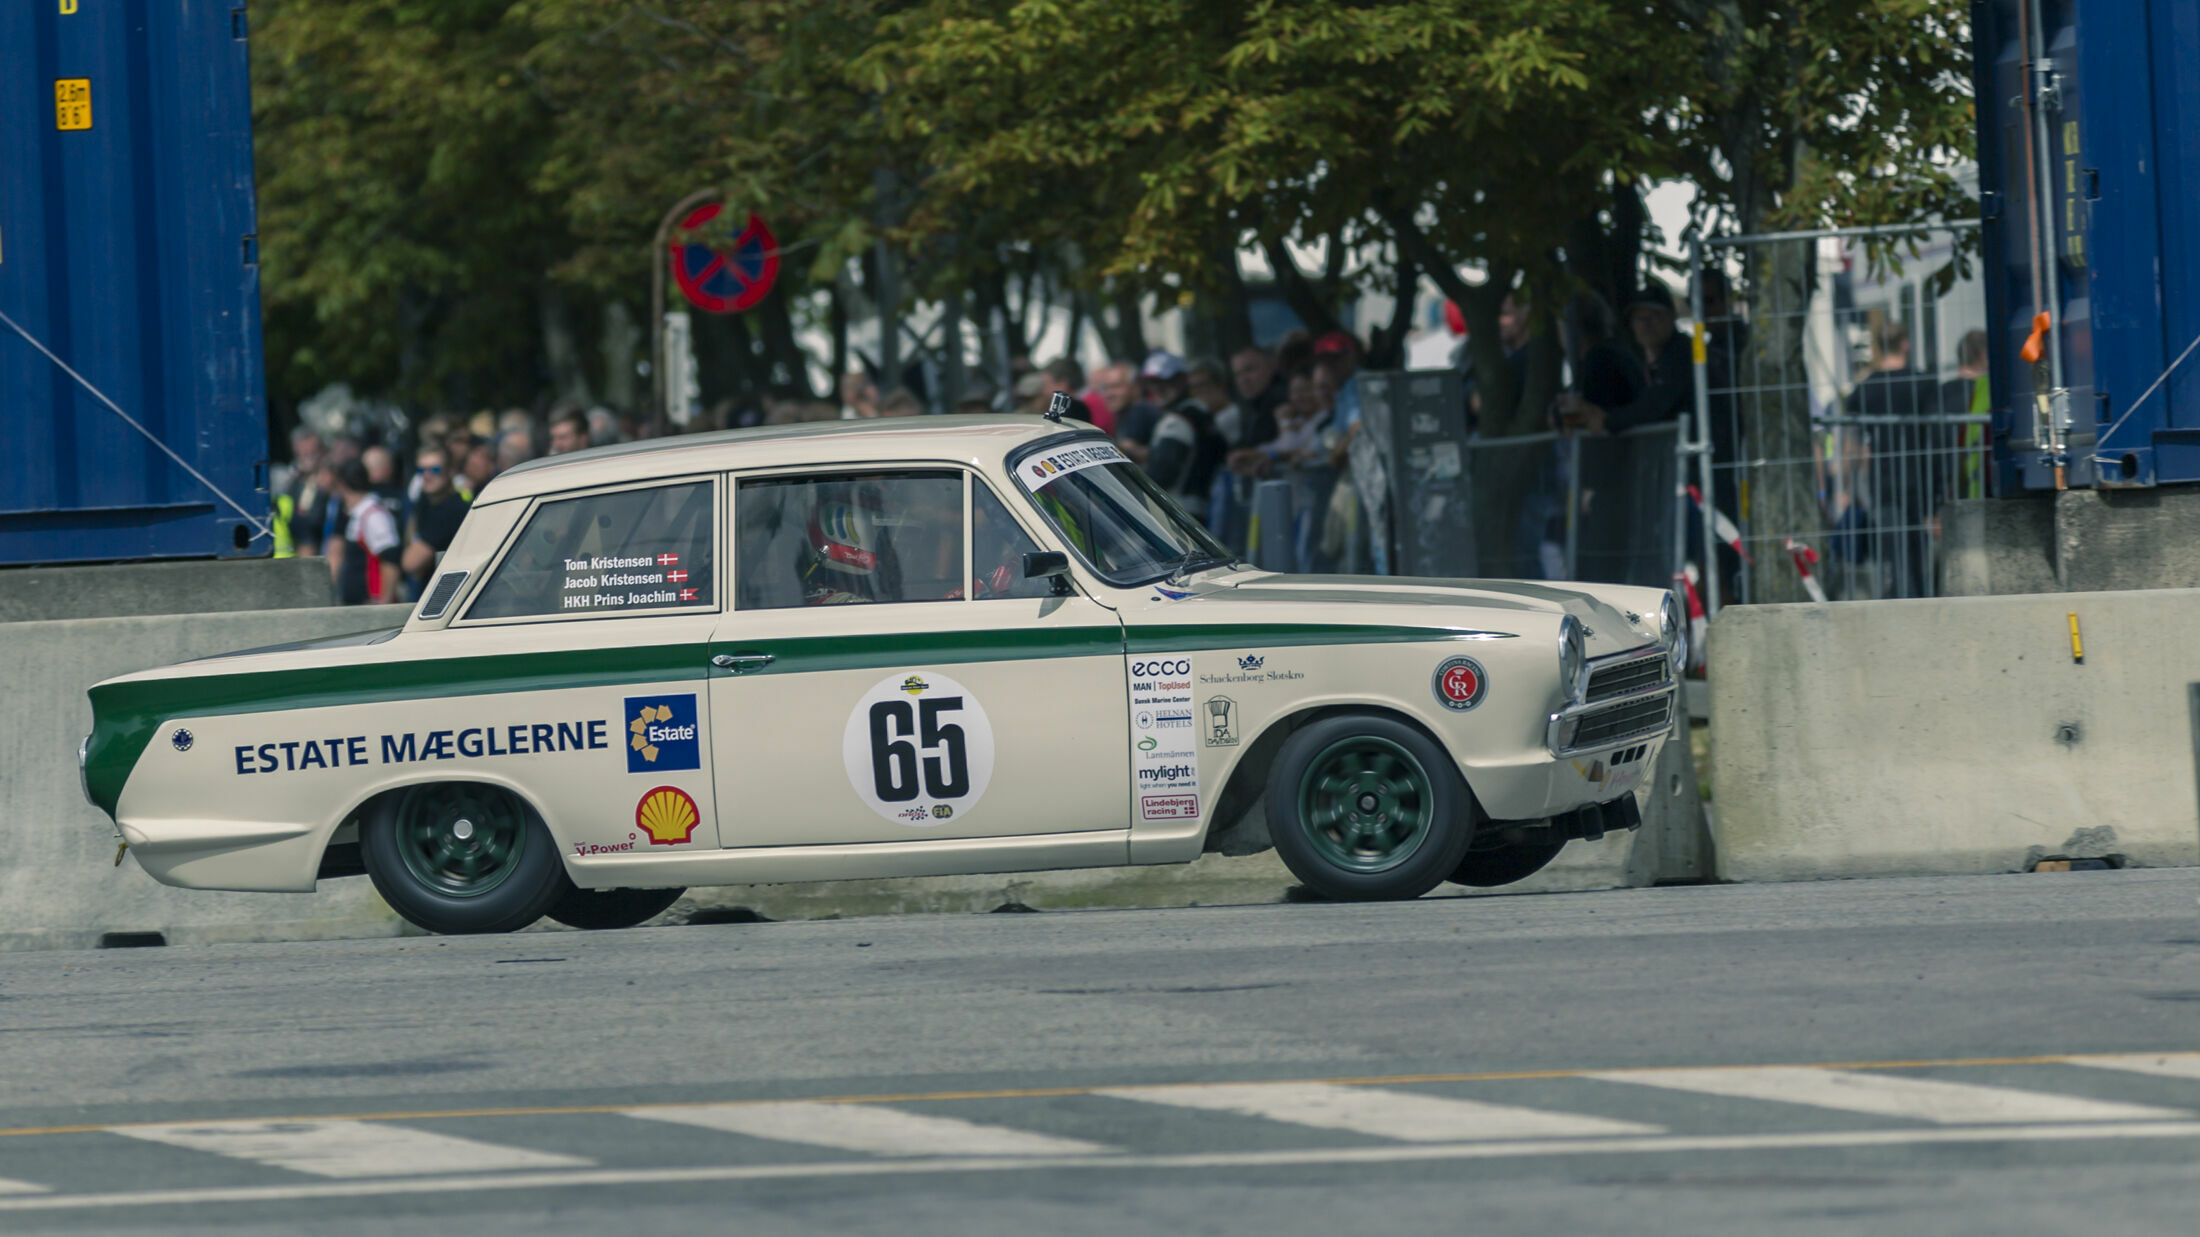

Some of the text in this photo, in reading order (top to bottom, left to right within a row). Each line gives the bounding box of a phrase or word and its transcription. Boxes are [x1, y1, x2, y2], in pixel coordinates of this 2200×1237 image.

[564, 557, 653, 571] Tom Kristensen
[564, 573, 663, 589] Jacob Kristensen
[564, 590, 676, 608] HKH Prins Joachim
[1132, 660, 1190, 677] ecco
[1266, 670, 1304, 681] Slotskro
[1133, 681, 1191, 691] MAN TopUsed
[1156, 720, 1192, 728] HOTELS
[649, 725, 694, 742] Estate
[235, 720, 608, 775] ESTATE MÆGLERNE
[869, 696, 970, 803] 65
[1146, 751, 1194, 759] Lantmännen
[1139, 765, 1190, 781] mylight
[1145, 799, 1194, 807] Lindebjerg
[933, 808, 951, 816] FIA
[576, 842, 635, 856] V-Power
